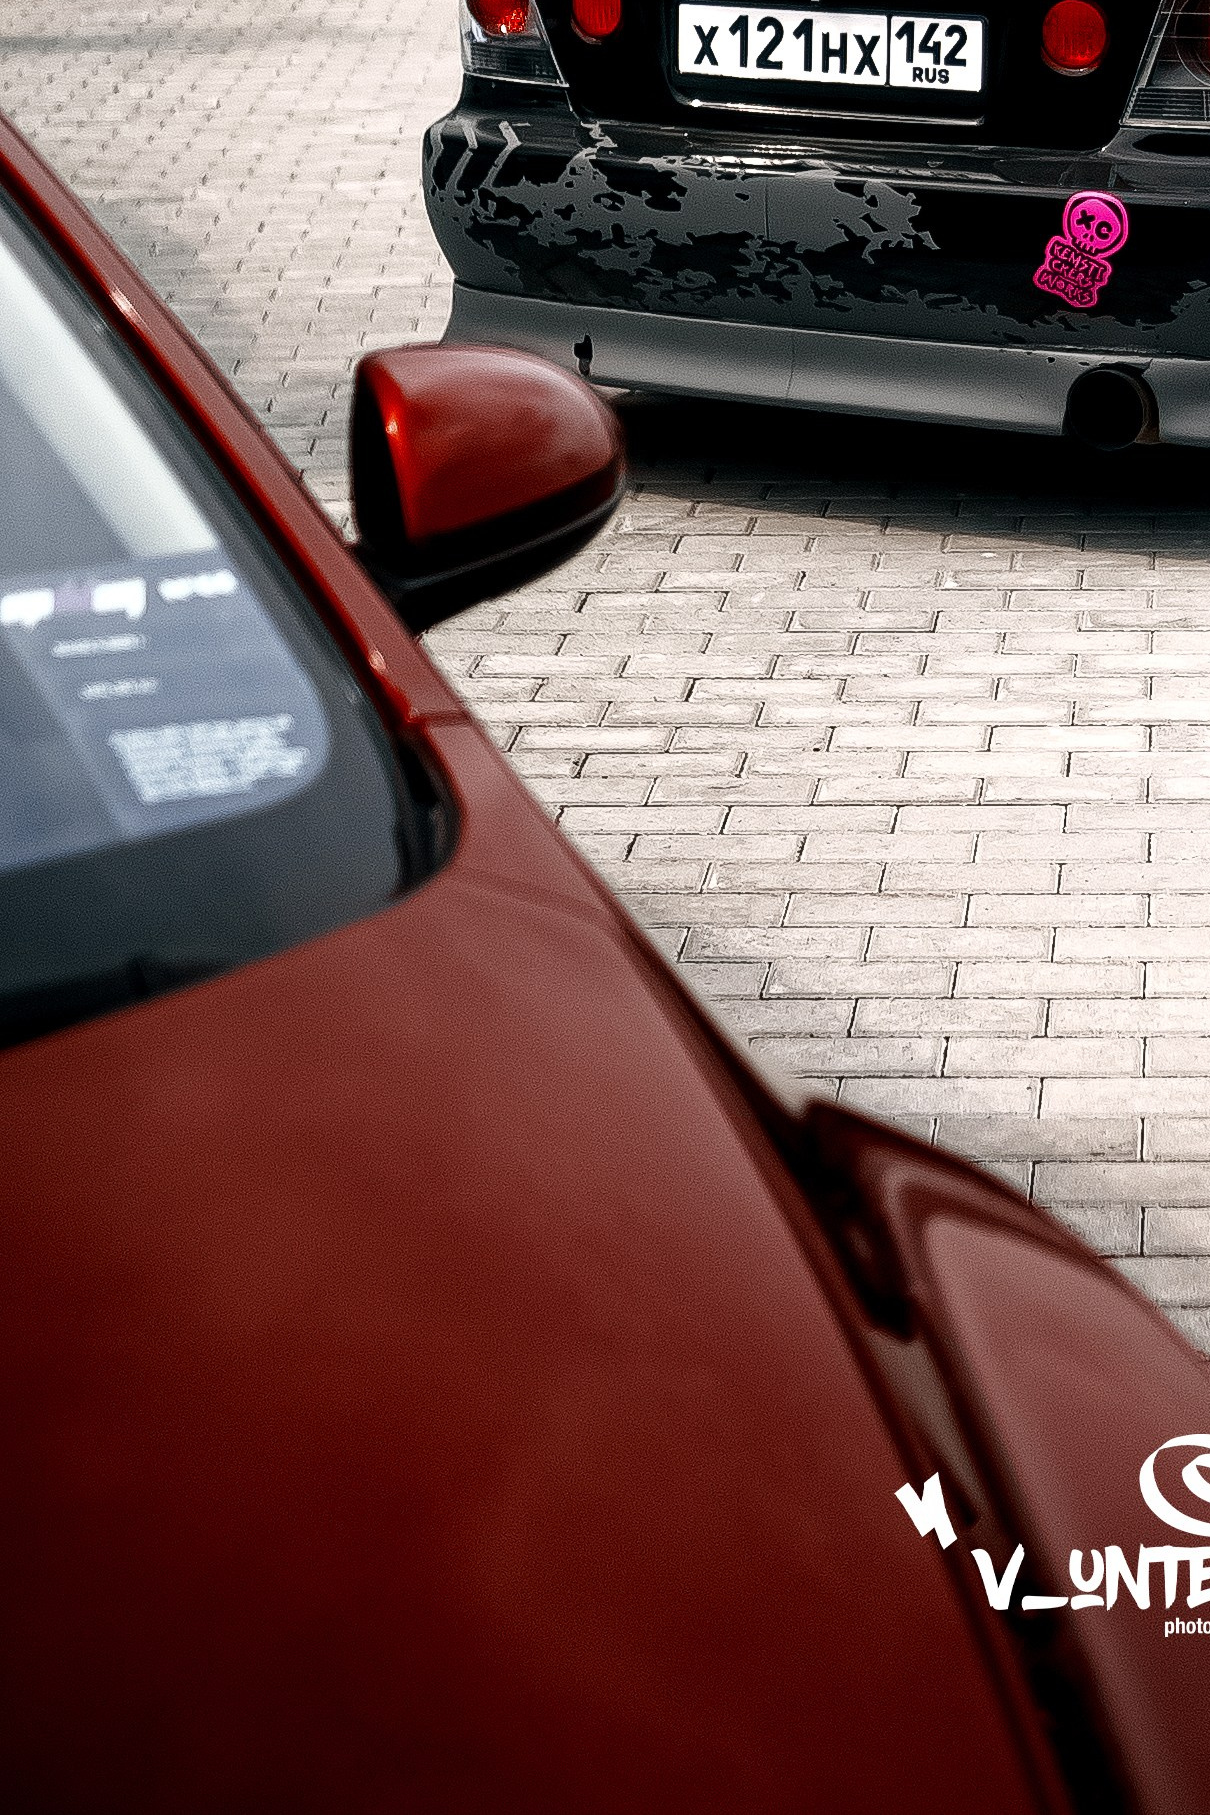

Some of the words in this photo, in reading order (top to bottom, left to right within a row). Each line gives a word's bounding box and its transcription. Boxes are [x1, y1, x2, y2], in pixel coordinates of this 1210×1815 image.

[895, 20, 968, 67] 142
[912, 66, 950, 84] RUS
[1041, 272, 1091, 302] WORKS
